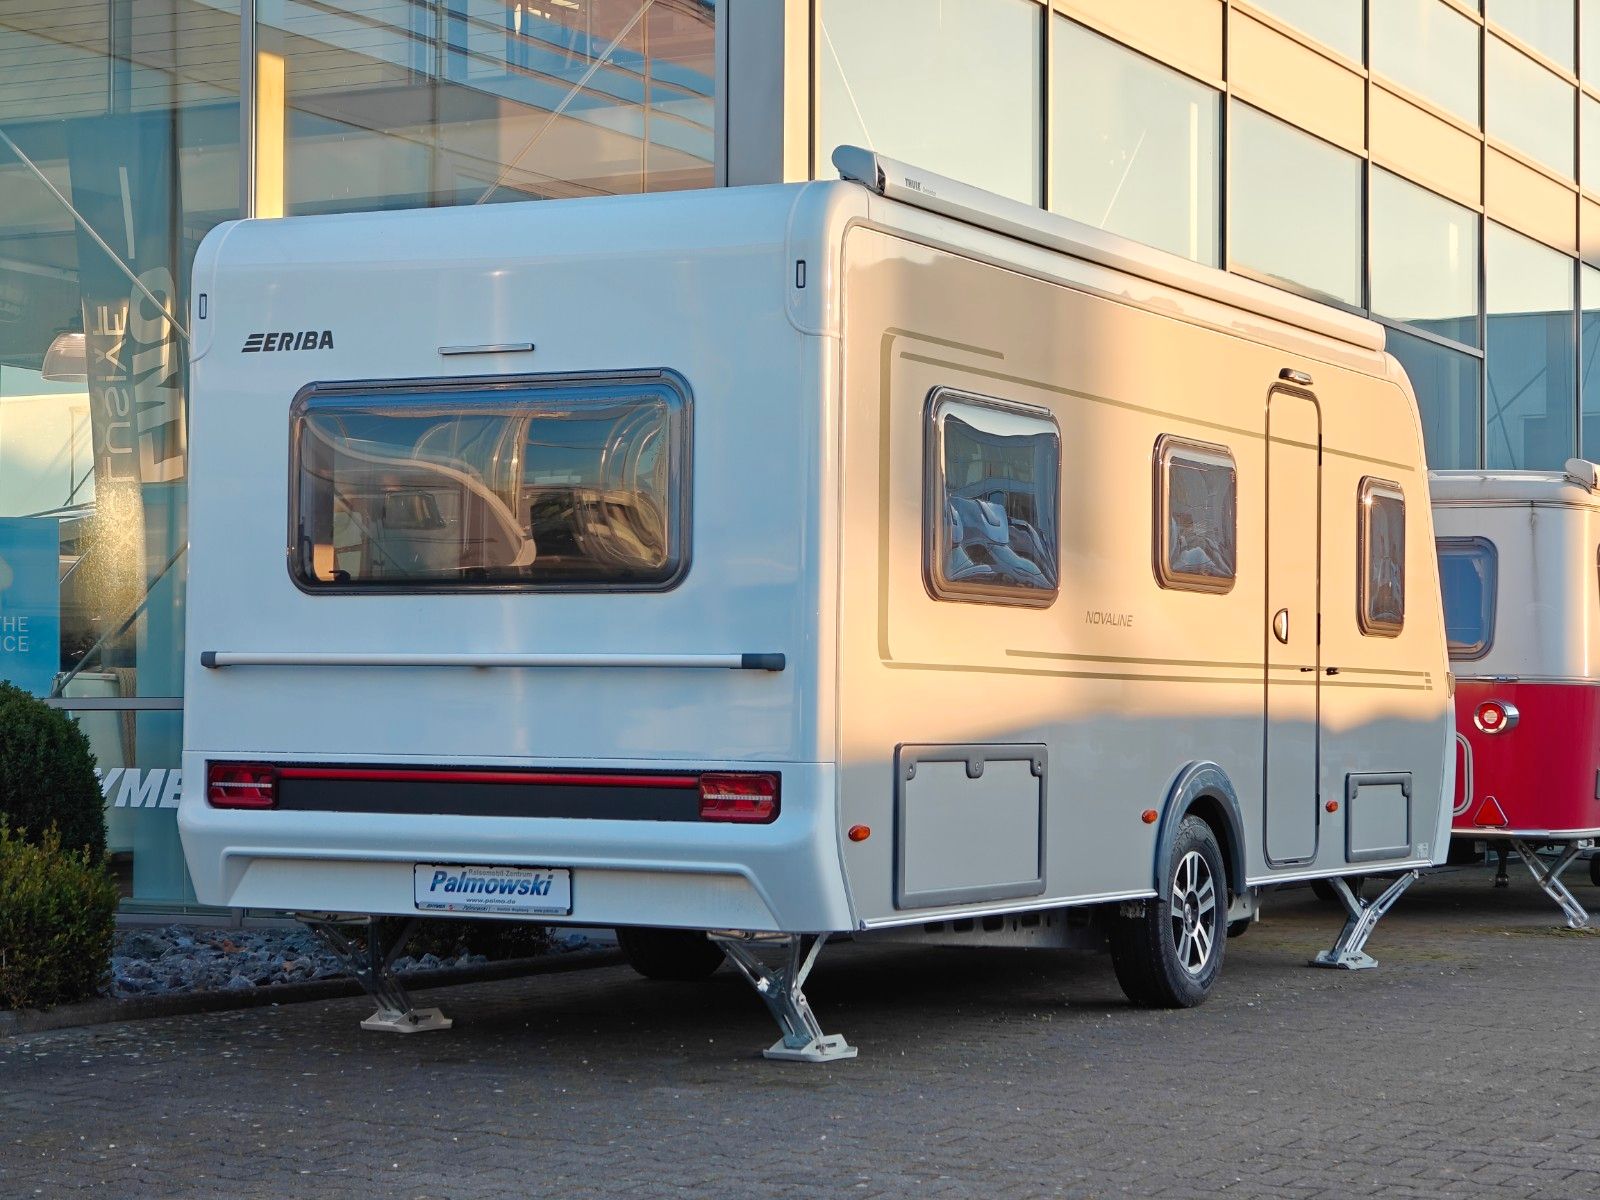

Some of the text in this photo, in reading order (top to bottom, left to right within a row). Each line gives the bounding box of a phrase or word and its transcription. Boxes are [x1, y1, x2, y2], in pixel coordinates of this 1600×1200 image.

[241, 330, 334, 353] ERIBA
[1085, 611, 1133, 627] NOVALINE
[0, 635, 29, 652] CE
[430, 870, 553, 895] Palmowski
[466, 898, 516, 906] www.palmo.de
